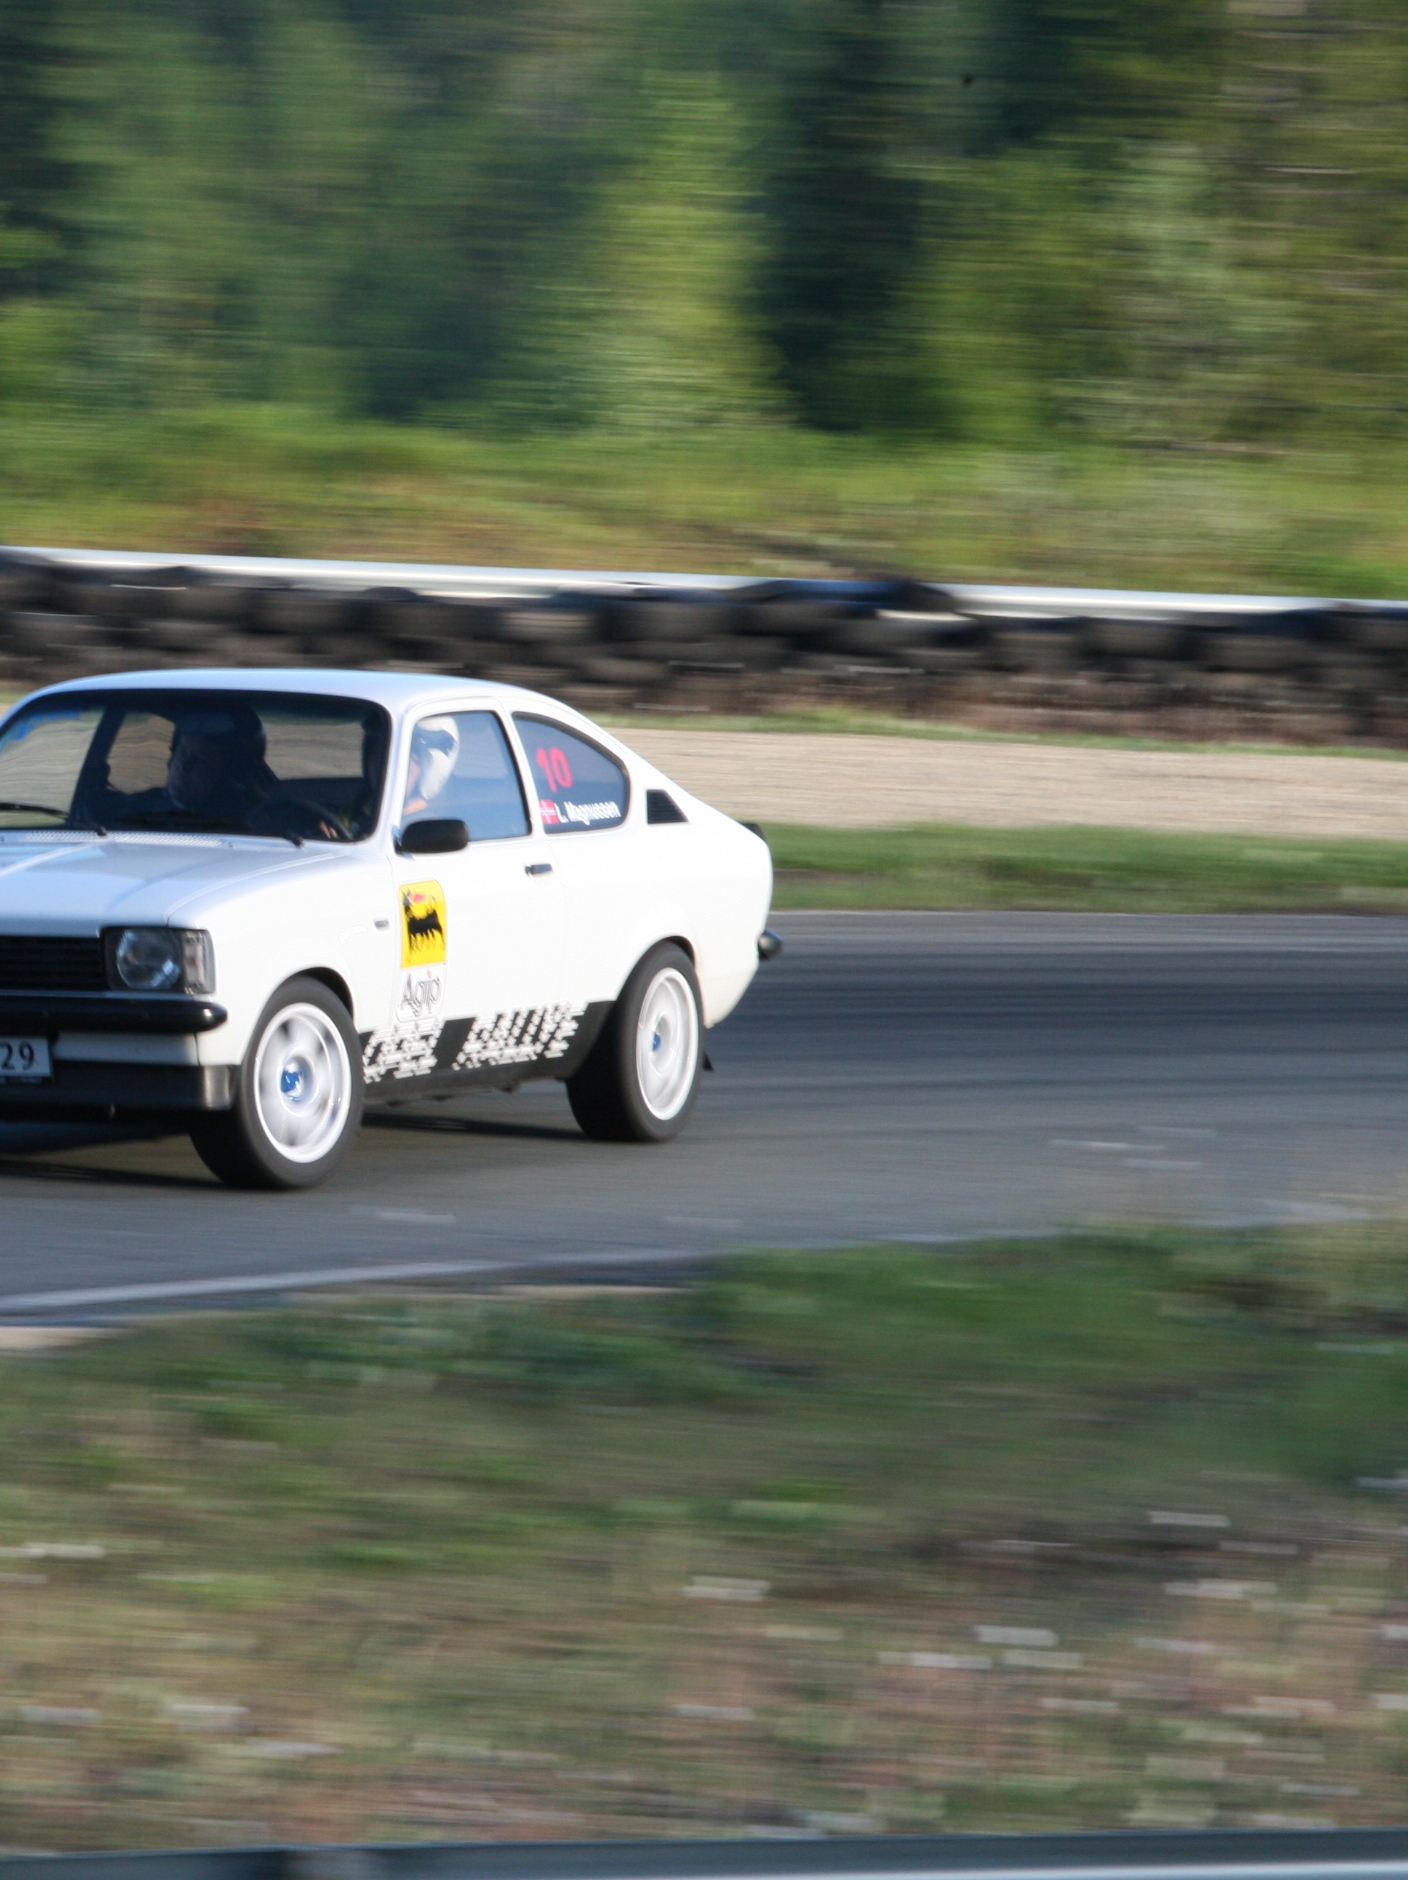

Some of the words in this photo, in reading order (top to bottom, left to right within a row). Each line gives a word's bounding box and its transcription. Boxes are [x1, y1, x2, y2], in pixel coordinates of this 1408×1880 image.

[536, 746, 575, 793] 10
[554, 802, 569, 823] L.
[400, 970, 443, 1018] Agip
